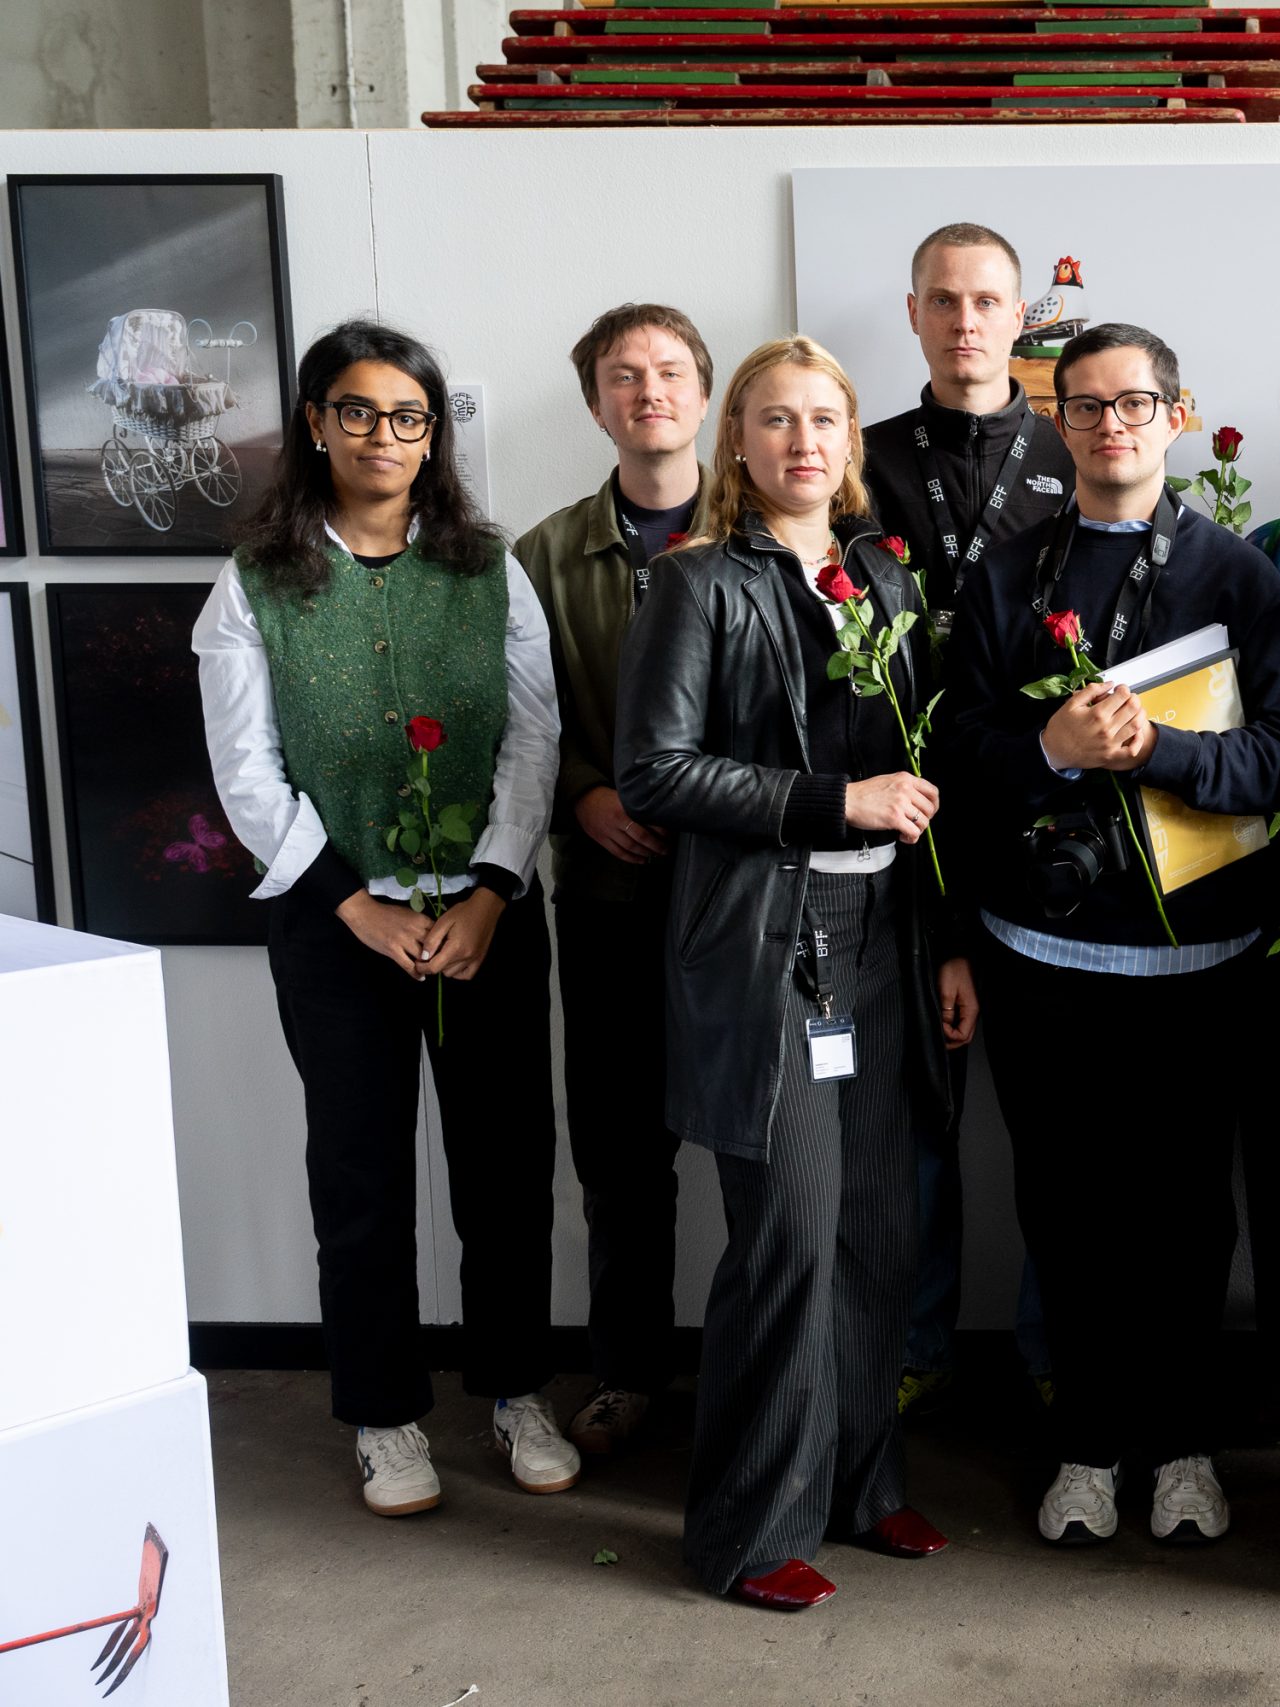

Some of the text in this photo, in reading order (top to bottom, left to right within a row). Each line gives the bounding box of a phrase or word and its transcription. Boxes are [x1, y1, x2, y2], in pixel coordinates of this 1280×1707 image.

[914, 425, 930, 449] BFF
[1010, 434, 1029, 460] BFF
[927, 478, 945, 503] BFF
[1026, 478, 1052, 488] NORTH
[1033, 485, 1052, 494] FACE
[1037, 474, 1052, 483] THE
[989, 484, 1008, 510] BFF
[943, 534, 960, 559] BFF
[966, 536, 986, 563] BFF
[1129, 556, 1150, 581] BFF
[1111, 612, 1128, 641] BFF
[815, 930, 829, 957] BFF
